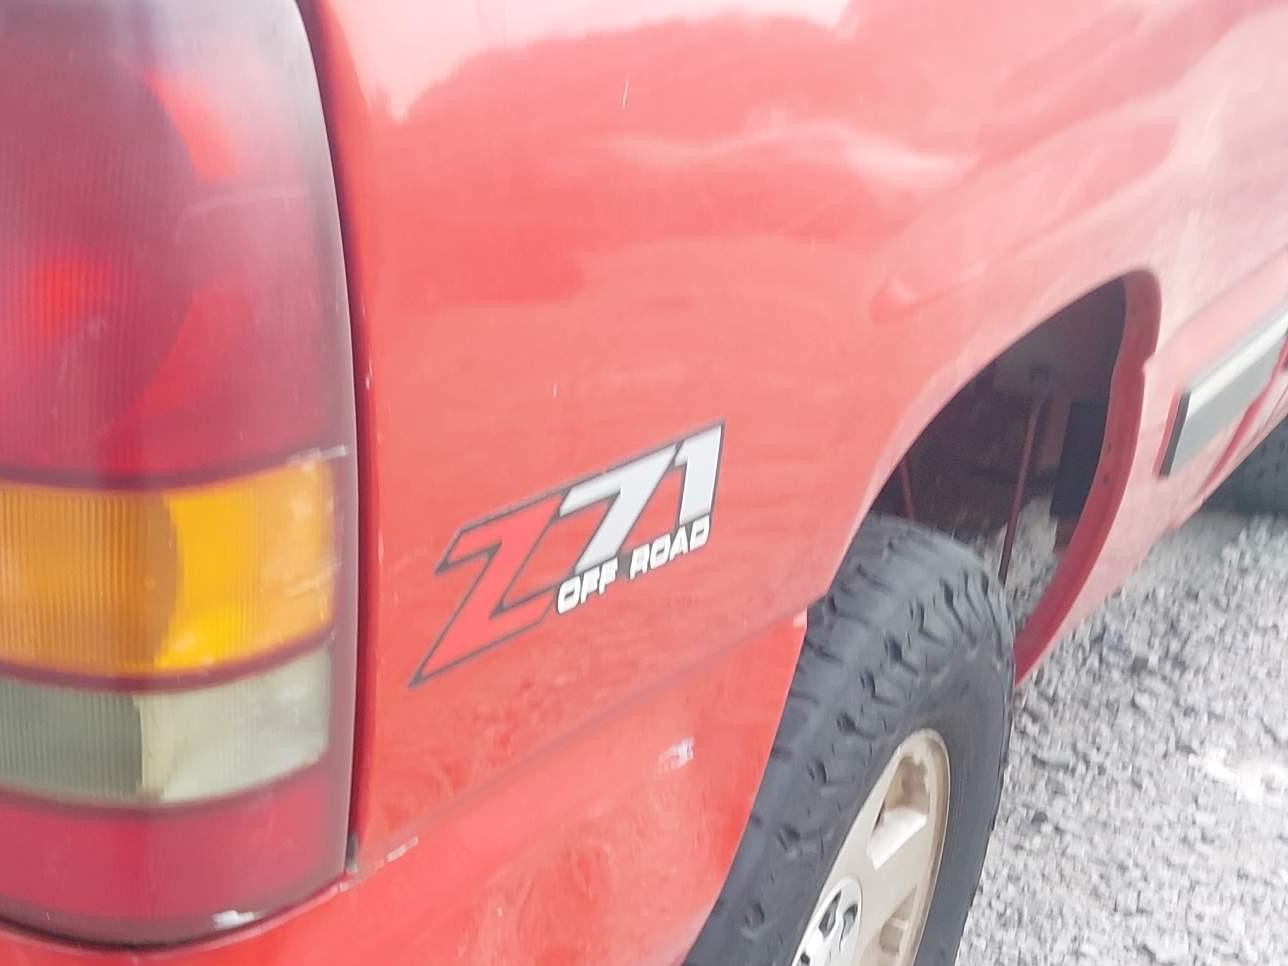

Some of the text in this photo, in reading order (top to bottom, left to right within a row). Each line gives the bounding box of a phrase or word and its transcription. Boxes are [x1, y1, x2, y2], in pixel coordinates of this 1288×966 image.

[407, 419, 725, 688] Z71
[556, 514, 711, 615] OFF ROAD
